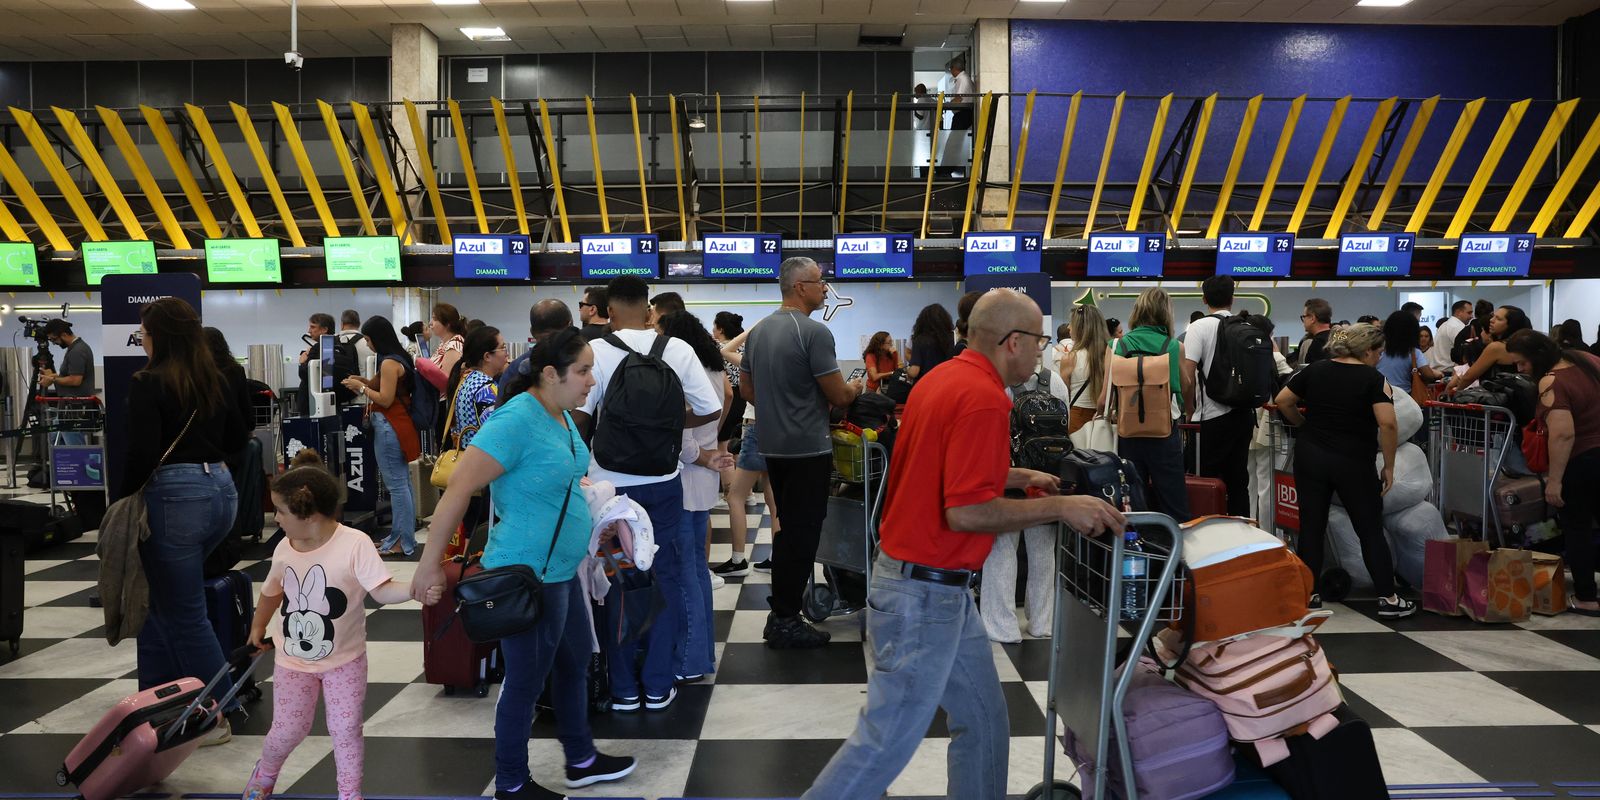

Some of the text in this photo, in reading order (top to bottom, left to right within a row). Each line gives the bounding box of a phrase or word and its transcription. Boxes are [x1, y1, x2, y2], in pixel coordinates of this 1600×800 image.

[458, 241, 486, 252] Azul
[511, 241, 524, 250] 70
[587, 241, 614, 252] Azul
[640, 240, 652, 250] 71
[709, 241, 737, 252] Azul
[763, 240, 776, 250] 72
[840, 241, 869, 252] Azul
[895, 239, 908, 249] 73
[970, 240, 998, 251] Azul
[1024, 238, 1037, 247] 74
[1094, 239, 1122, 251] Azul
[1148, 239, 1160, 248] 75
[1223, 239, 1251, 251] Azul
[1276, 239, 1289, 248] 76
[1343, 239, 1372, 251] Azul
[1397, 238, 1410, 248] 77
[1464, 240, 1493, 251] Azul
[1517, 239, 1531, 248] 78
[475, 268, 508, 276] DIAMANTE
[588, 268, 620, 276] BAGAGEM
[710, 267, 774, 275] BAGAGEM EXPRESSA
[842, 267, 906, 275] BAGAGEM EXPRESSA
[987, 265, 1018, 273] CHECK-IN
[127, 295, 173, 304] DIAMAN
[1419, 315, 1430, 323] zul
[346, 447, 364, 493] Azul
